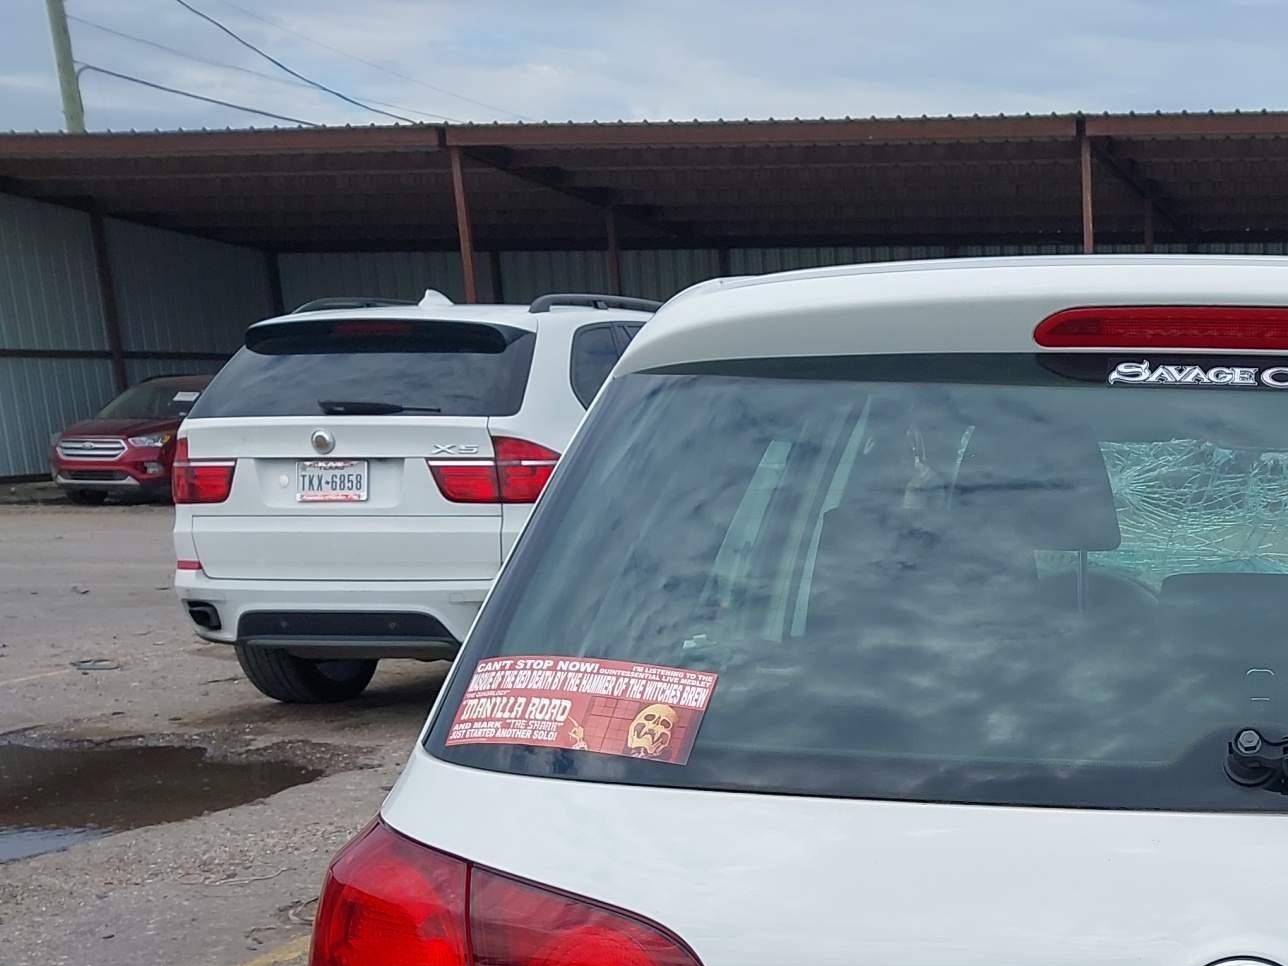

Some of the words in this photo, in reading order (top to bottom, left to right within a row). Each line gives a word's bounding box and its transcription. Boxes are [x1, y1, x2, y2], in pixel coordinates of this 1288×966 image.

[1108, 359, 1258, 385] SAVAGE
[431, 444, 479, 455] X5
[477, 661, 513, 673] CAN'T
[515, 660, 553, 670] STOP
[556, 660, 599, 673] NOW!
[599, 668, 660, 681] QUINTESSENTIAL
[661, 676, 679, 684] LIVE
[680, 679, 711, 688] MEDLEY
[645, 667, 684, 678] LISTENING
[686, 672, 697, 681] TO
[698, 674, 713, 683] THE
[500, 671, 518, 690] THE
[513, 671, 532, 689] RED
[528, 671, 557, 690] DEATH
[552, 671, 567, 691] BY
[564, 672, 583, 692] THE
[578, 674, 617, 695] HAMMER
[613, 678, 629, 697] OF
[626, 679, 646, 699] THE
[642, 681, 683, 704] WITCHES
[680, 687, 709, 708] BREW
[525, 697, 572, 721] ROAD
[453, 722, 473, 732] AND
[473, 720, 503, 730] MARK
[466, 728, 495, 738] STARTED
[495, 728, 532, 738] ANOTHER
[532, 731, 558, 741] SOLO!
